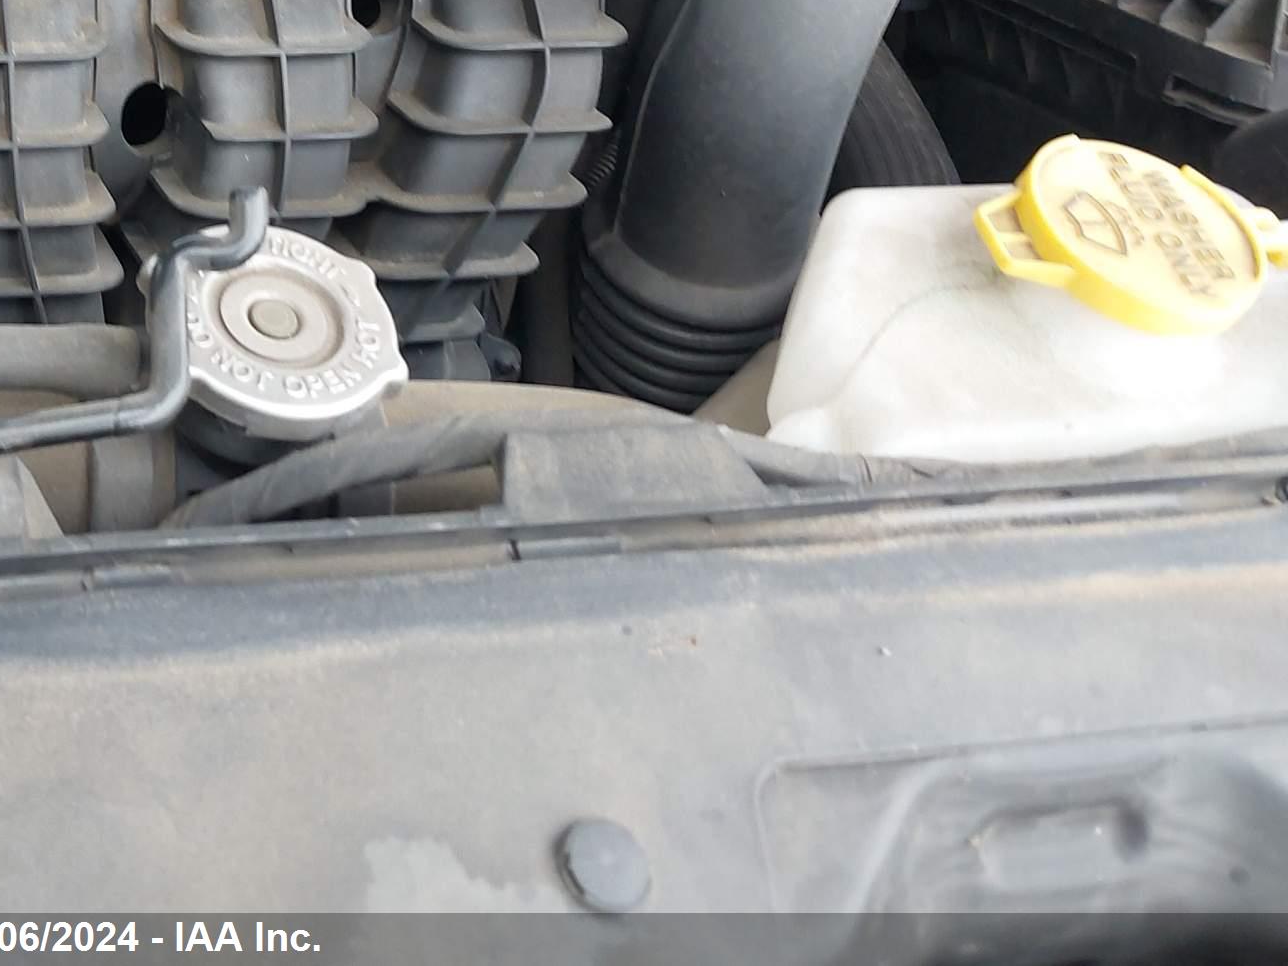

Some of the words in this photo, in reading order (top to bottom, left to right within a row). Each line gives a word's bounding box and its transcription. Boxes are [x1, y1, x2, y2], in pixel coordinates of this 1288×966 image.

[1097, 151, 1165, 221] FLUID
[1153, 231, 1218, 298] ONLY
[1142, 171, 1236, 280] WASHER
[210, 349, 275, 392] NOT
[282, 366, 363, 400] OPEN
[350, 319, 382, 370] HOT
